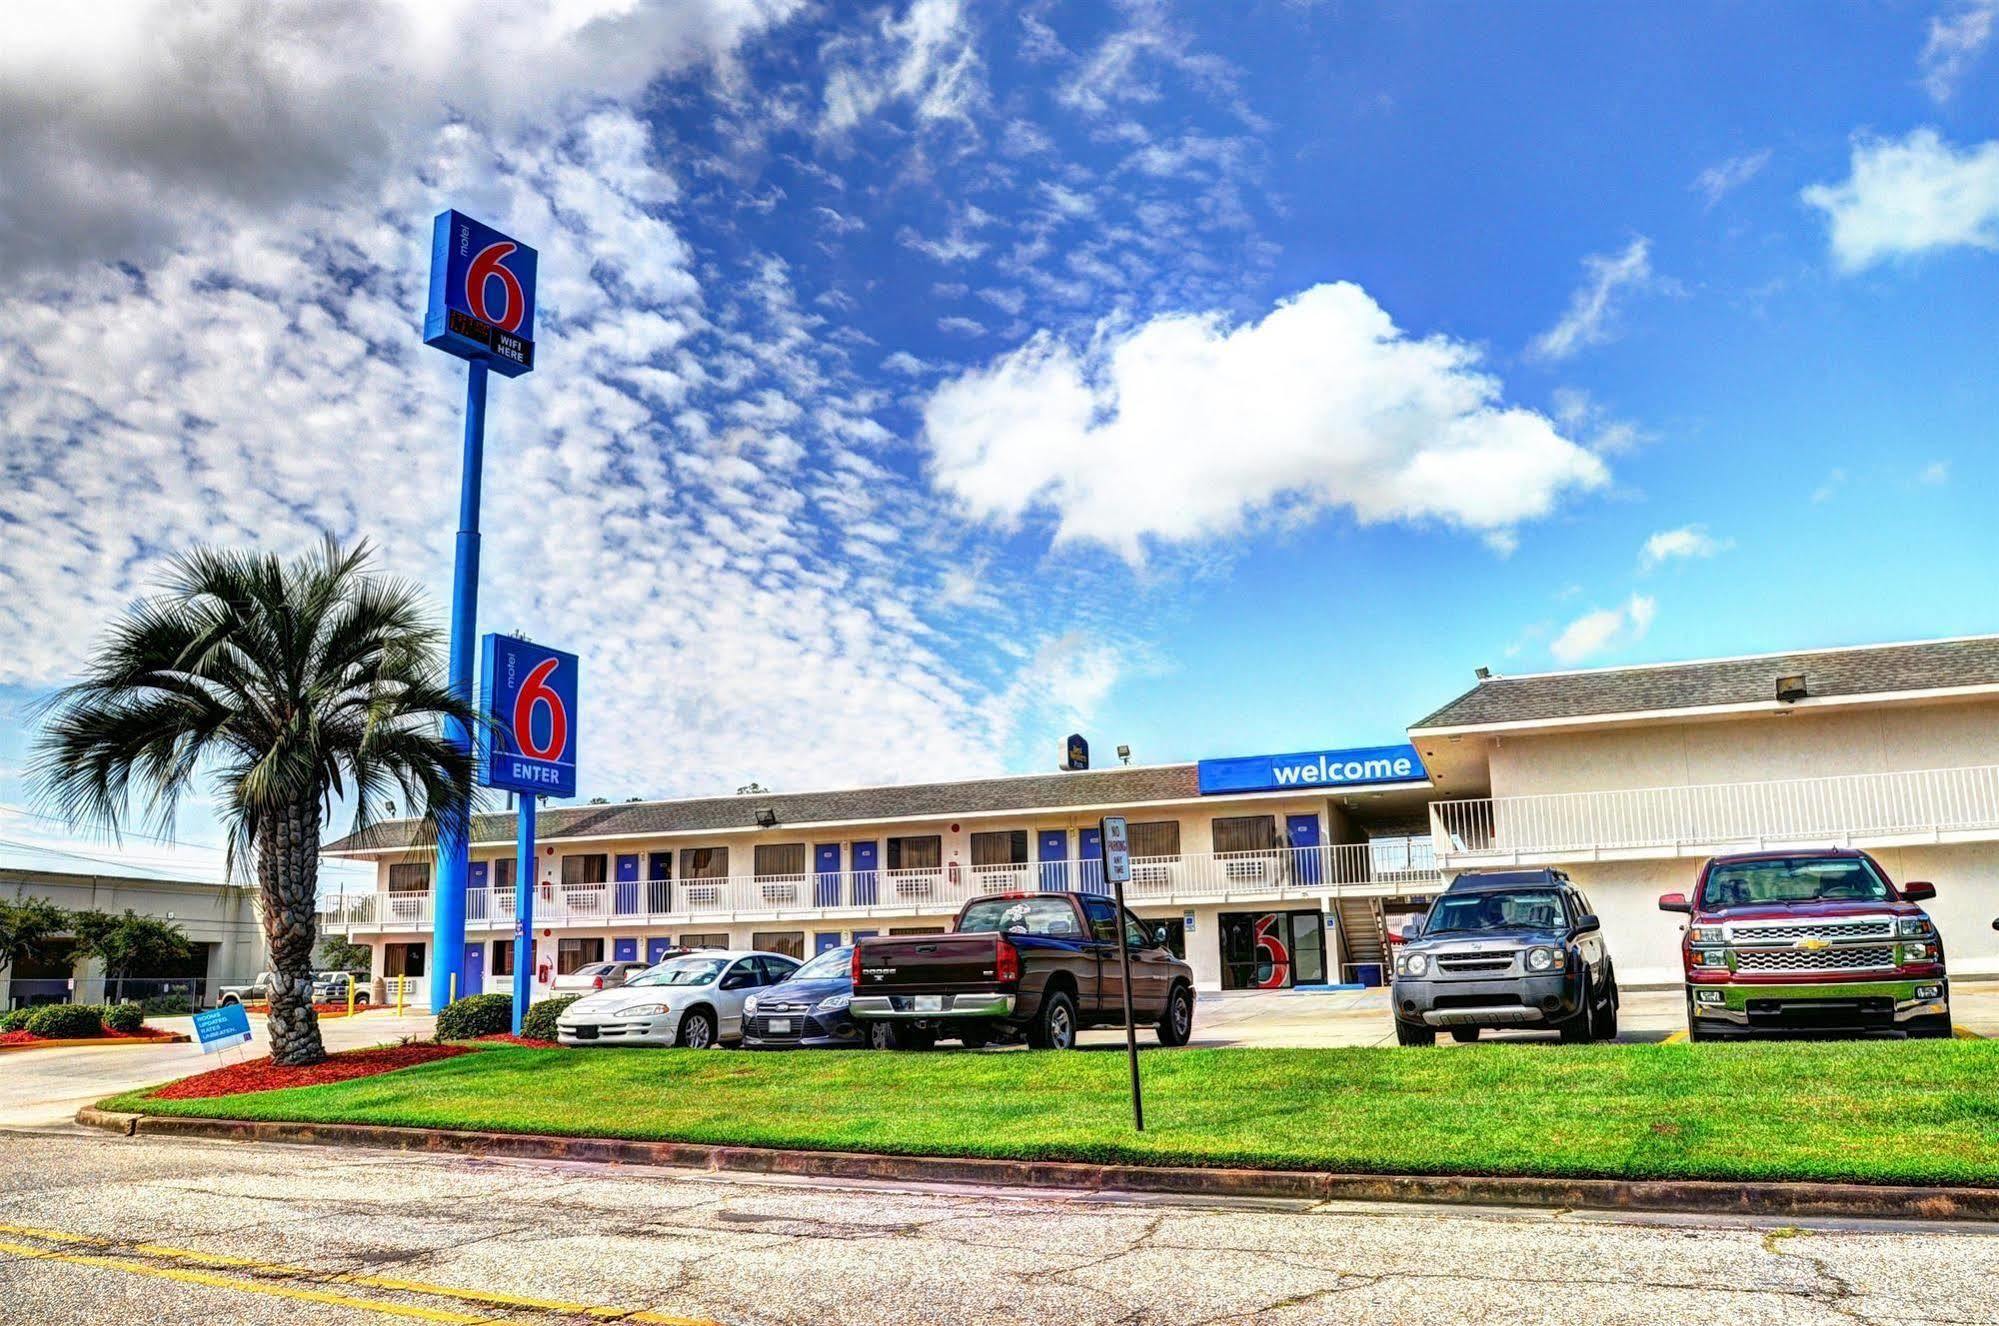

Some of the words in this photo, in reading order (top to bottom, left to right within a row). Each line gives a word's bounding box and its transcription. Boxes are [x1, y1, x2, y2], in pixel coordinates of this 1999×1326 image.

[460, 224, 469, 257] motel
[465, 242, 525, 333] 6
[498, 345, 523, 362] HERE
[500, 335, 521, 351] WIFI
[508, 653, 516, 688] motel
[513, 657, 567, 762] 6
[513, 763, 560, 784] ENTER
[1273, 755, 1412, 785] welcome
[197, 1012, 221, 1022] ROOMS
